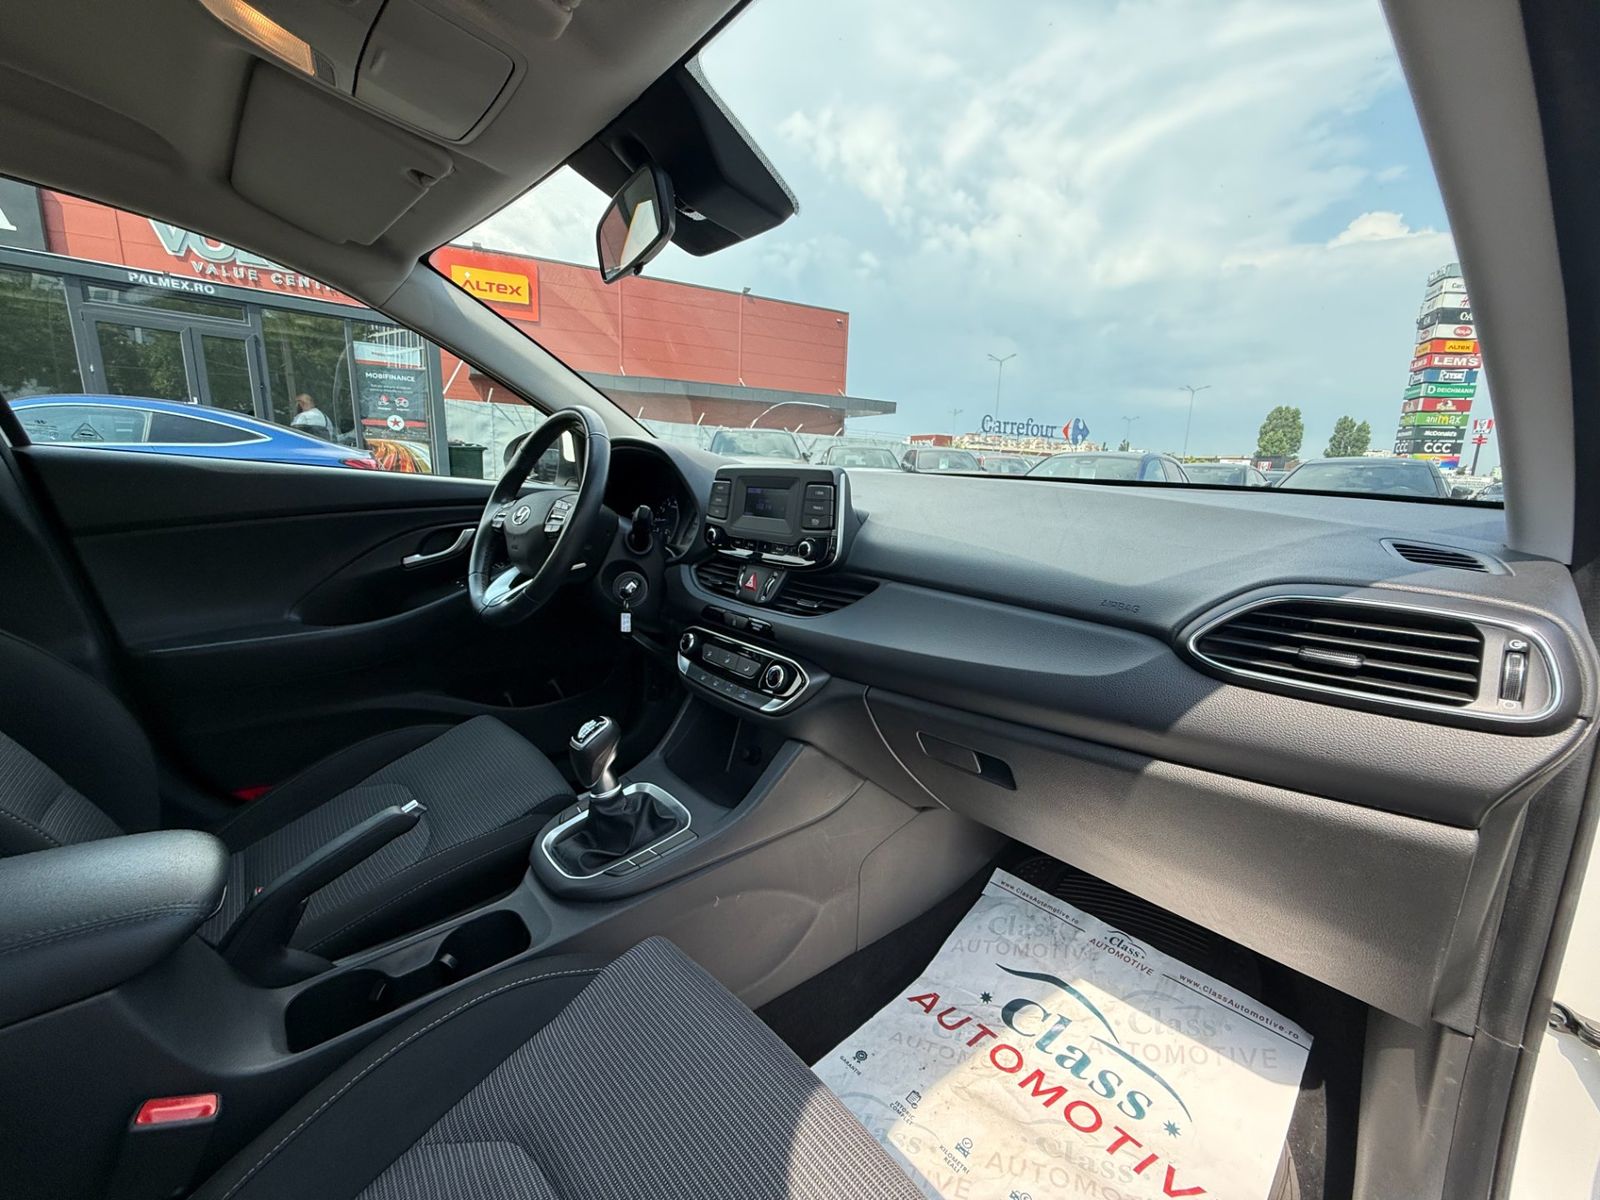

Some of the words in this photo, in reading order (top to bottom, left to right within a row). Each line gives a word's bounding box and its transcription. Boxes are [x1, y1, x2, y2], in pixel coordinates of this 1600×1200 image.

[190, 260, 258, 281] VALUE
[127, 271, 215, 295] PALMEX.RO
[1433, 356, 1479, 367] LEMS
[365, 371, 416, 383] MOBIFINANCE
[980, 414, 1057, 438] Carrefour
[1426, 414, 1462, 425] animax
[1424, 442, 1452, 453] CCC
[1089, 938, 1155, 976] AUTOMOTIVE
[1109, 935, 1141, 959] Class
[1179, 973, 1300, 1041] www.ClassAutomotive.ro
[1000, 998, 1153, 1121] Class
[939, 1144, 970, 1174] KILOMETRI
